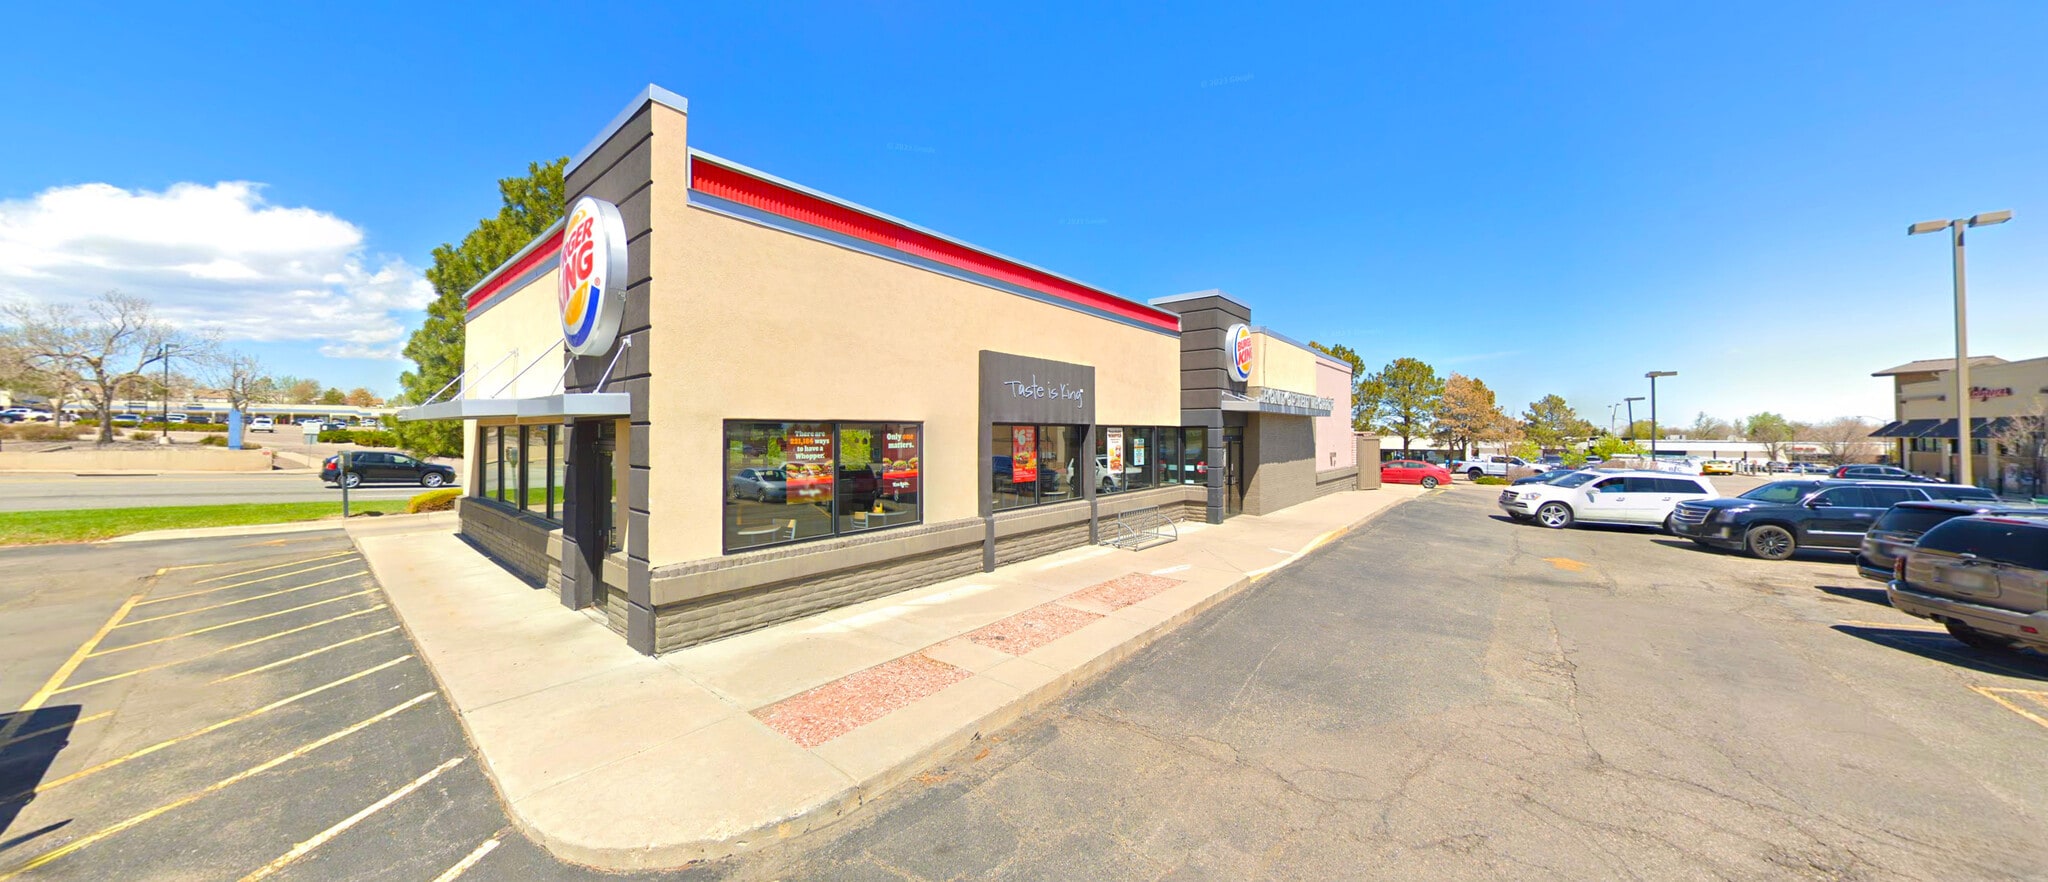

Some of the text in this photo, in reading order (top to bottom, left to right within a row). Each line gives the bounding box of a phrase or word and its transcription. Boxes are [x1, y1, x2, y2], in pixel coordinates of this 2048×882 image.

[1004, 374, 1083, 408] Taste is King
[886, 433, 902, 442] Only
[814, 438, 830, 446] ways
[888, 441, 915, 449] matters.
